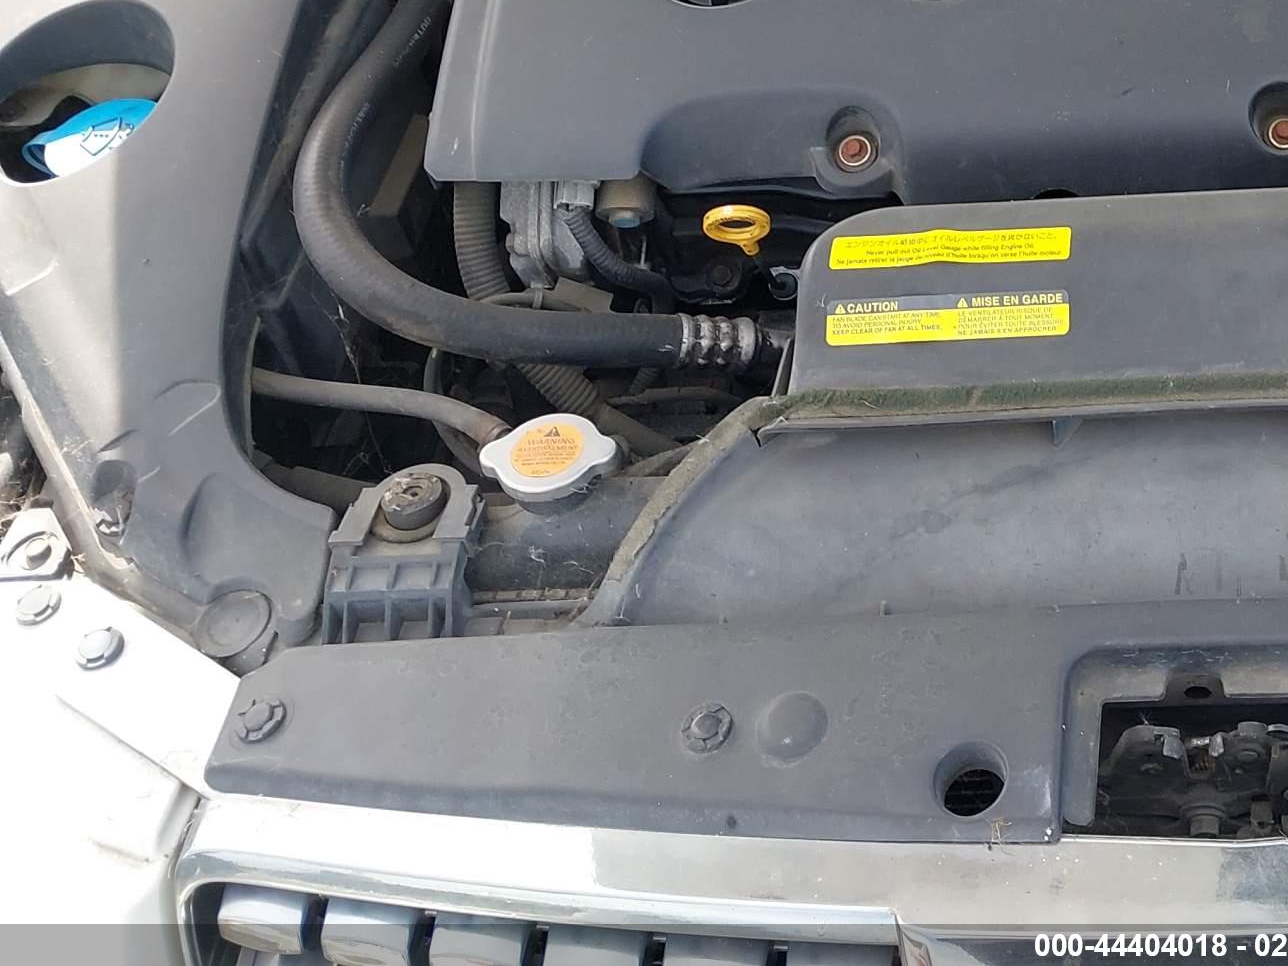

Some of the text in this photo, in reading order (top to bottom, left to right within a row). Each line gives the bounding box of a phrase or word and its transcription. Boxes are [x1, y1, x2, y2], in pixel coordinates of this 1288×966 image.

[963, 243, 980, 251] while
[1000, 242, 1022, 252] Engine
[971, 293, 1063, 308] MISE EN GARDE
[846, 301, 898, 314] CAUTION
[850, 328, 874, 336] CLEAR
[906, 324, 919, 332] ALL
[864, 320, 898, 328] PERSONAL
